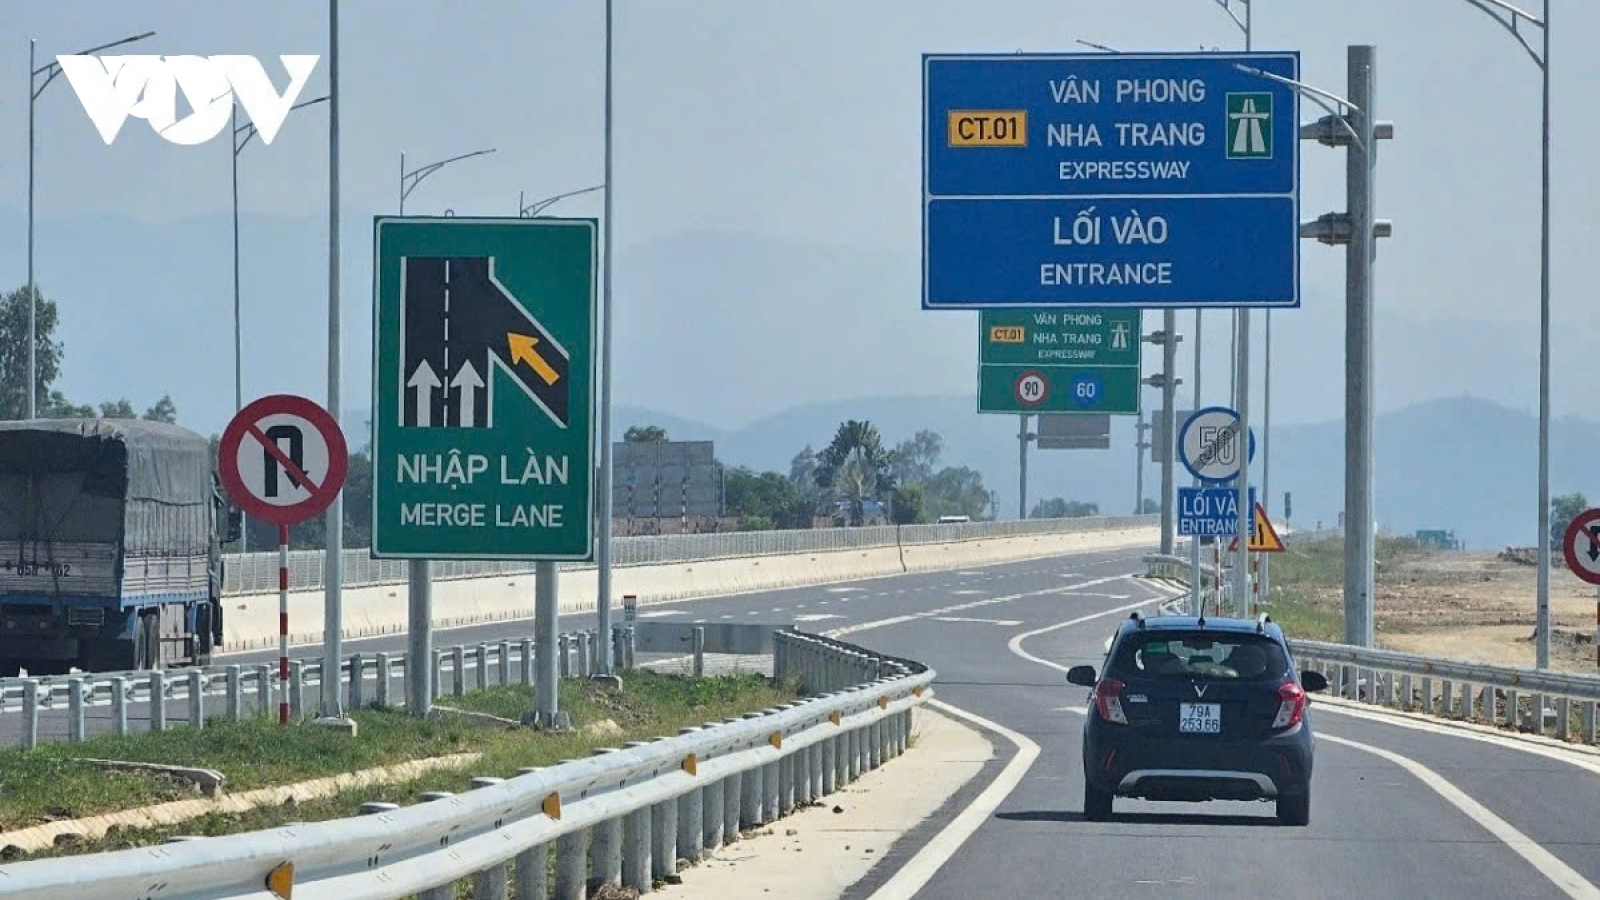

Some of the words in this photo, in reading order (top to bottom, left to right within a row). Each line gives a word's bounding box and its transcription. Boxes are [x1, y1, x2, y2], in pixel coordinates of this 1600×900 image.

[1049, 75, 1099, 104] VÂN
[1116, 79, 1205, 103] PHONG
[957, 117, 1018, 141] CT.01
[1047, 123, 1102, 147] NHA
[1114, 122, 1205, 145] TRANG
[1059, 161, 1191, 180] EXPRESSWAY
[1053, 206, 1100, 246] LỐI
[1111, 208, 1168, 245] VÀO
[1040, 263, 1172, 285] ENTRANCE
[1063, 313, 1102, 326] PHONG
[994, 329, 1021, 340] CT.01
[1033, 333, 1058, 344] NHA
[1062, 333, 1101, 344] TRANG
[1038, 350, 1097, 359] EXPRESSWAY
[1024, 381, 1038, 396] 90
[1076, 382, 1096, 398] 60
[1199, 426, 1236, 466] 50
[396, 448, 489, 490] NHẬP
[500, 447, 569, 486] LÀN
[1183, 489, 1210, 516] LỐI
[1215, 491, 1238, 516] VÀ
[401, 503, 486, 527] MERGE
[495, 504, 564, 528] LANE
[1189, 704, 1211, 718] 79A
